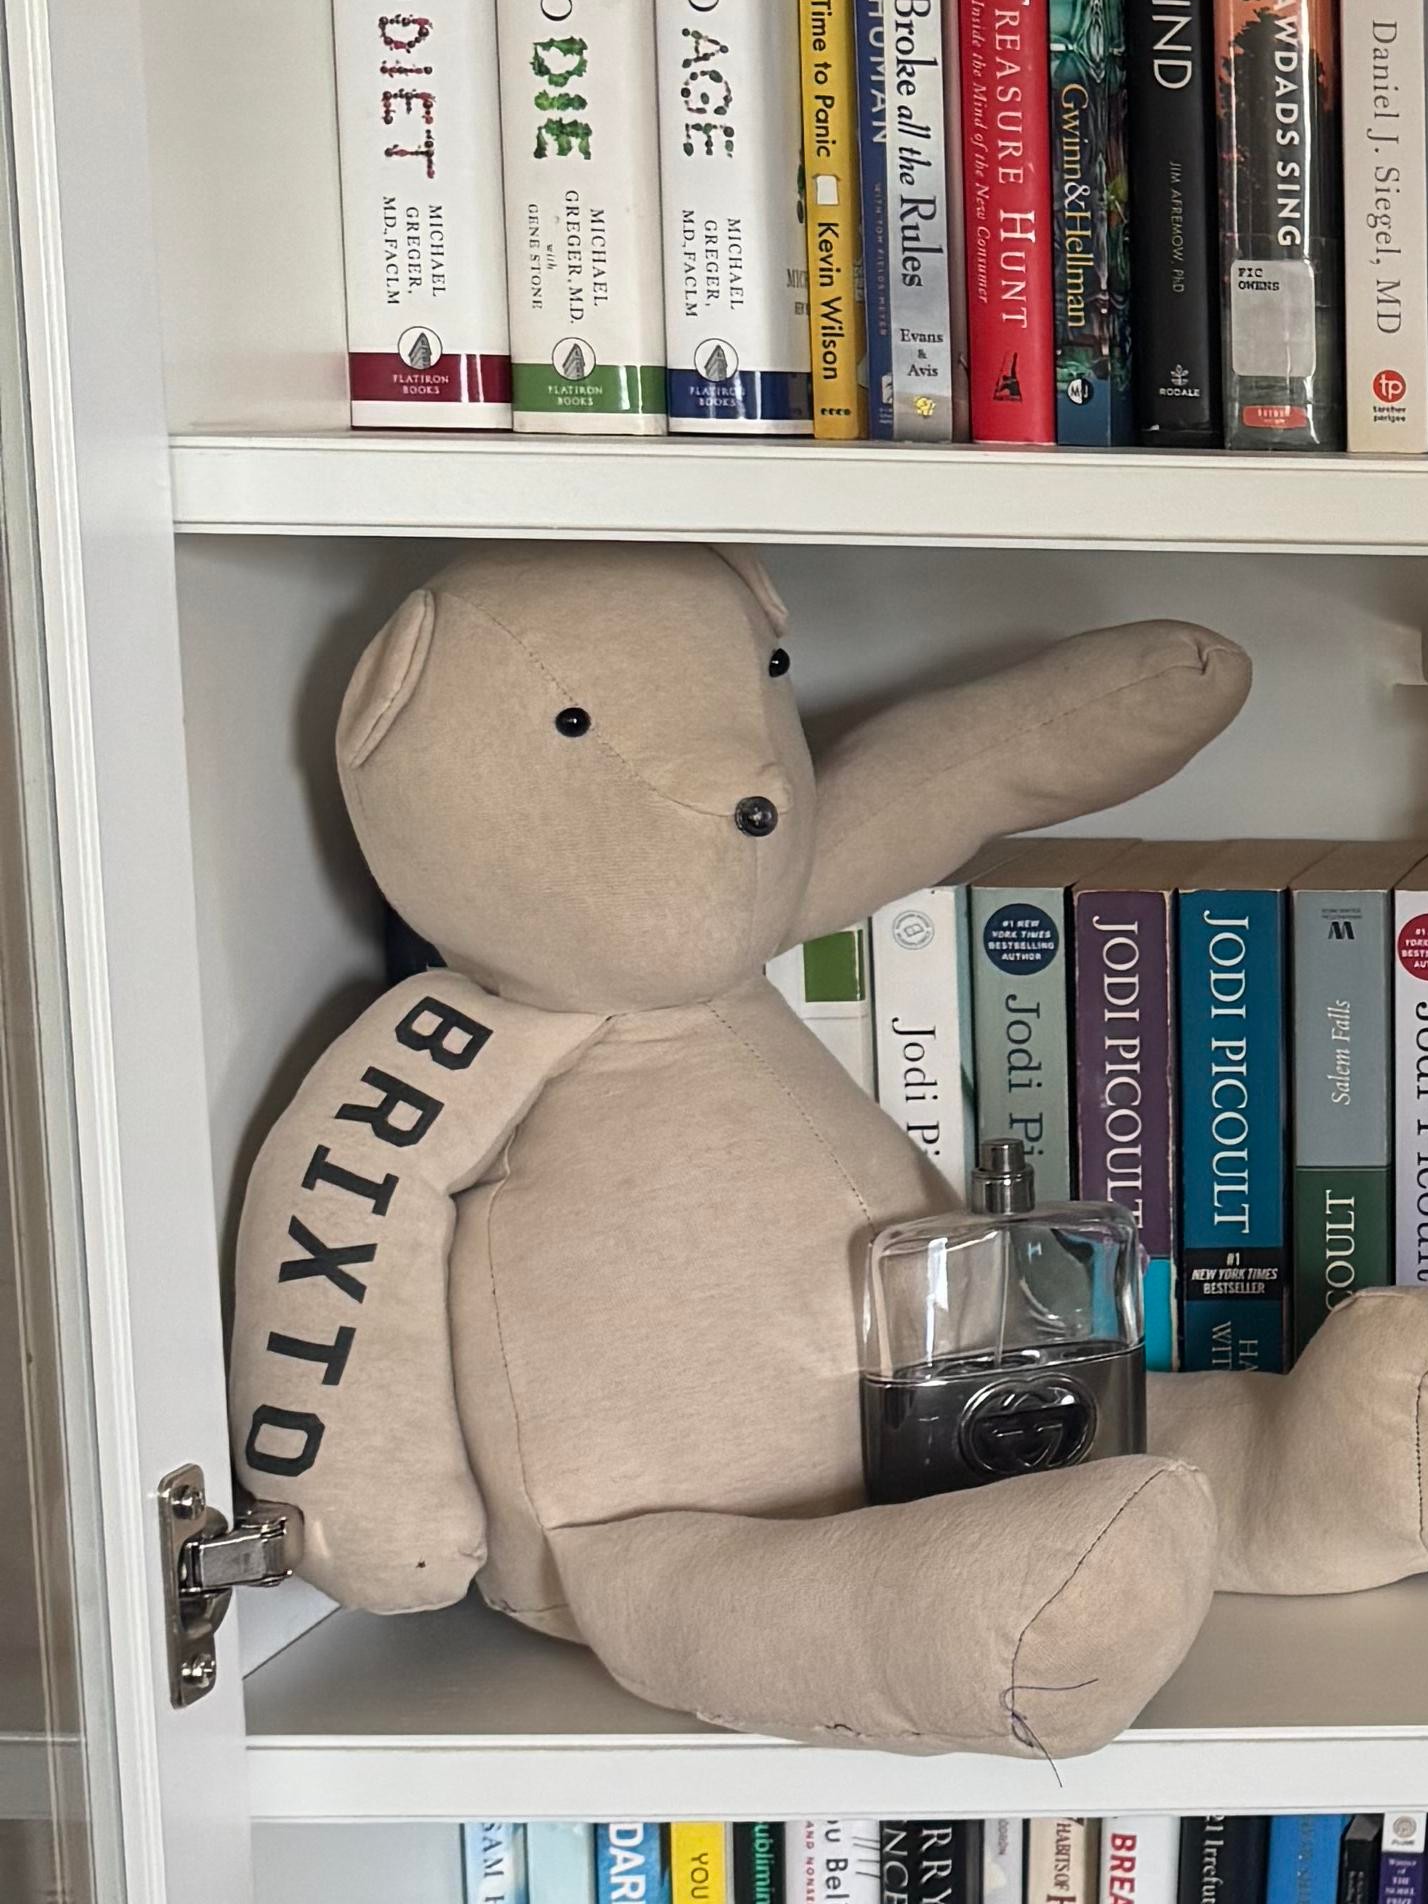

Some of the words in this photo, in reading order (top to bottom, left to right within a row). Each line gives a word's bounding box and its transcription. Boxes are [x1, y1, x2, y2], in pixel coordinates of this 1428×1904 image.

[404, 206, 422, 295] GREGER,
[427, 205, 446, 297] MICHAEL
[819, 222, 839, 285] Kevin
[1238, 281, 1280, 291] OWENS
[821, 294, 839, 381] Wilson
[900, 328, 944, 345] Evans
[908, 362, 939, 378] Avis
